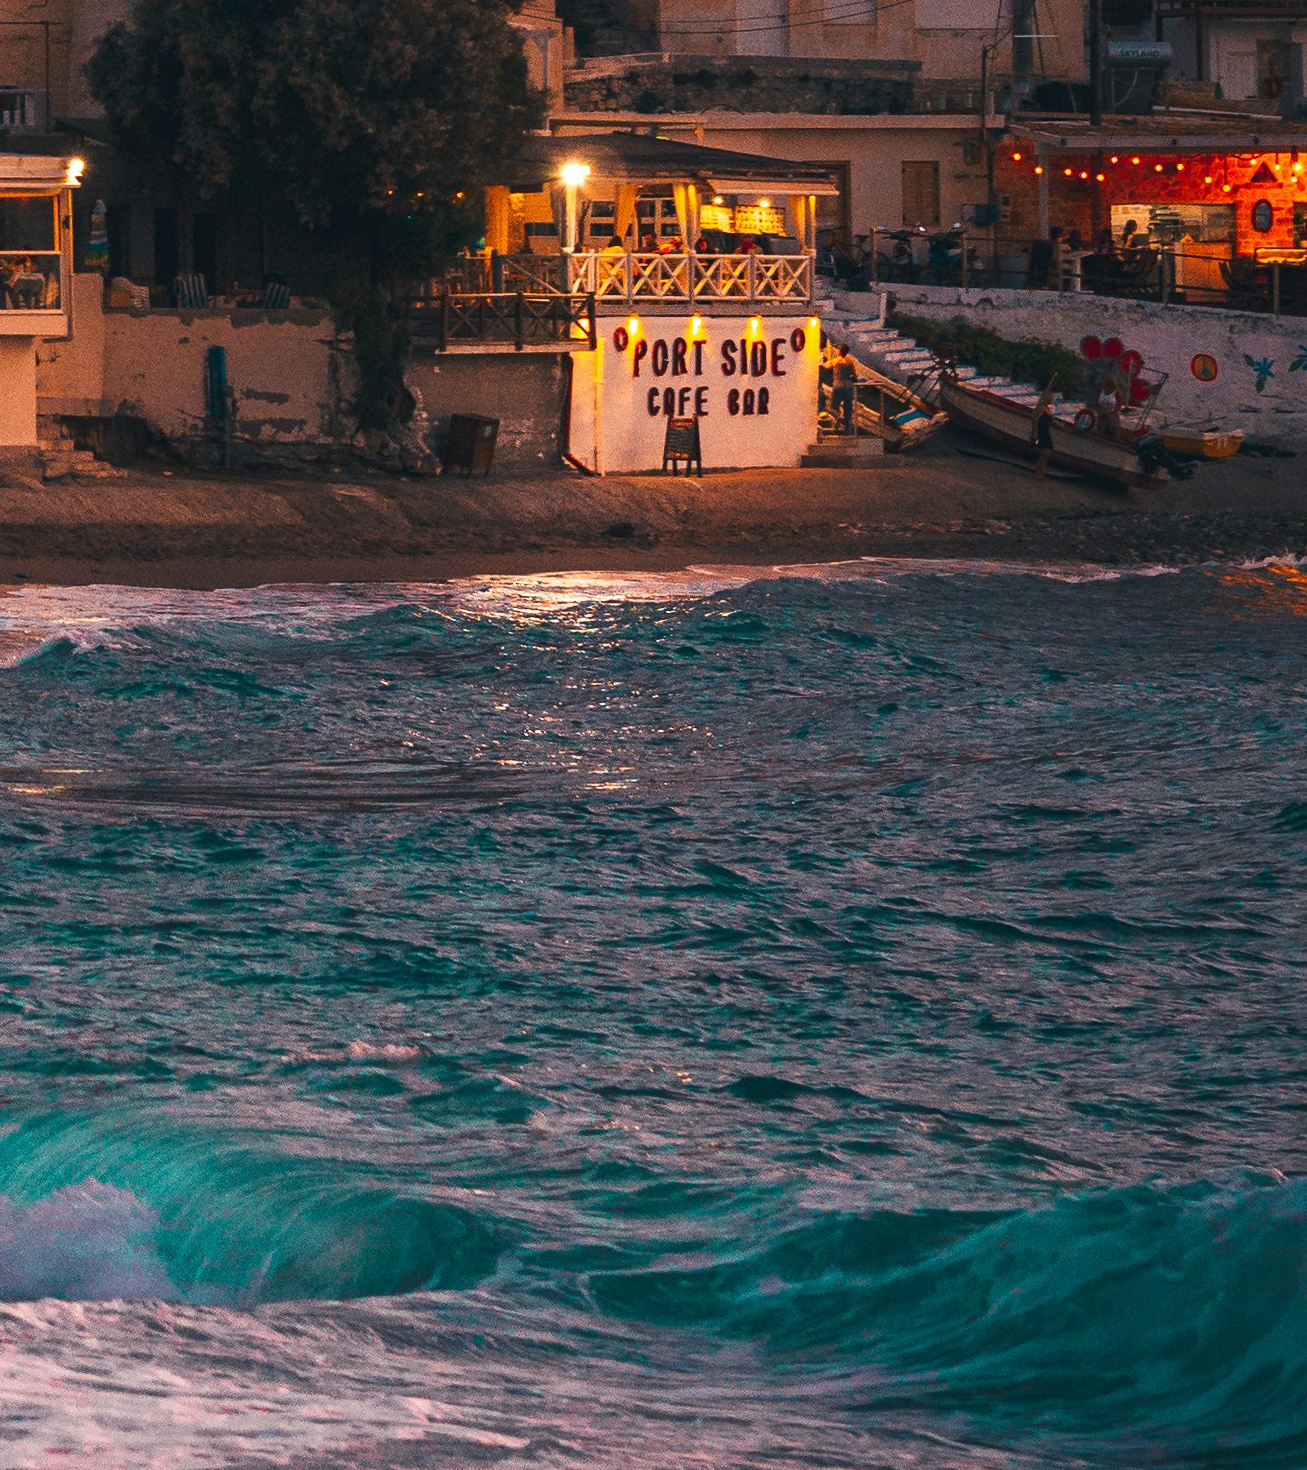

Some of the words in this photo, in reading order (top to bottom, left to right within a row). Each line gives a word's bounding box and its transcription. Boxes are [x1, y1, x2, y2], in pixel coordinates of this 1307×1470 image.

[633, 337, 707, 377] PORT
[721, 338, 787, 377] SIDE
[647, 386, 709, 416] CAFE
[727, 387, 769, 415] BAR
